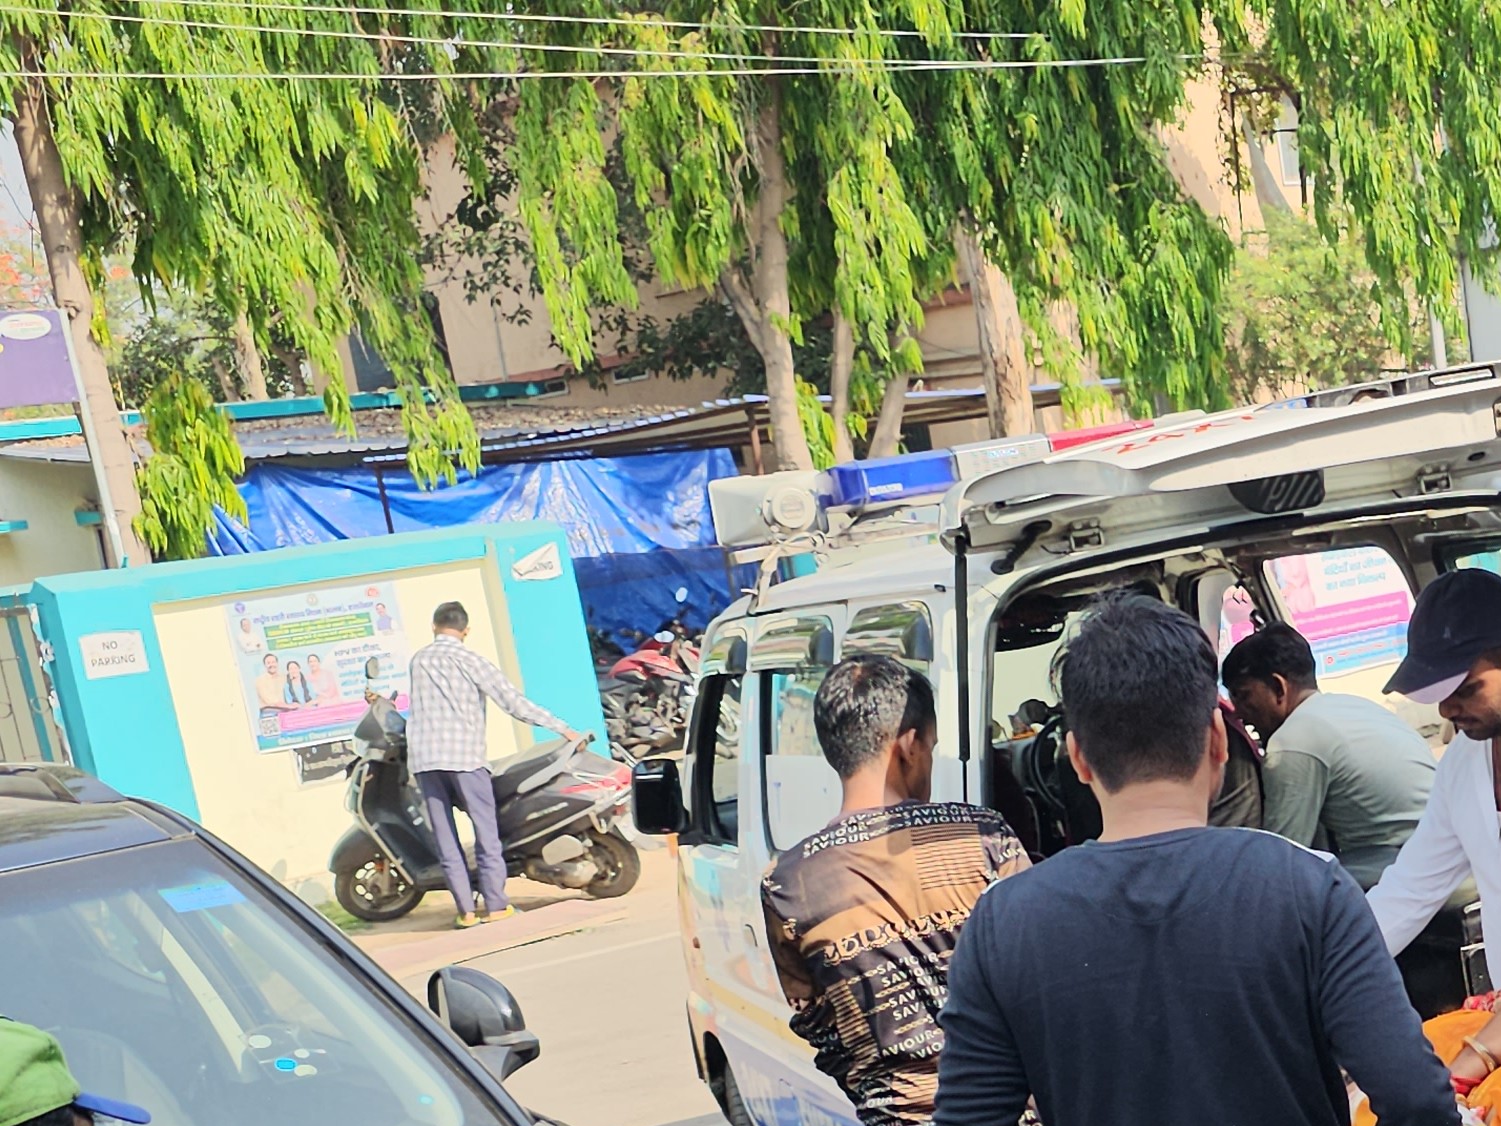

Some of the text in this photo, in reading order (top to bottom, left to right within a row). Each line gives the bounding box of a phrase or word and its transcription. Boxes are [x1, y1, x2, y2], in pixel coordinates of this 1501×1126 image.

[101, 640, 118, 650] NO
[90, 654, 136, 667] PARKING
[802, 831, 870, 859] SAVIOUR
